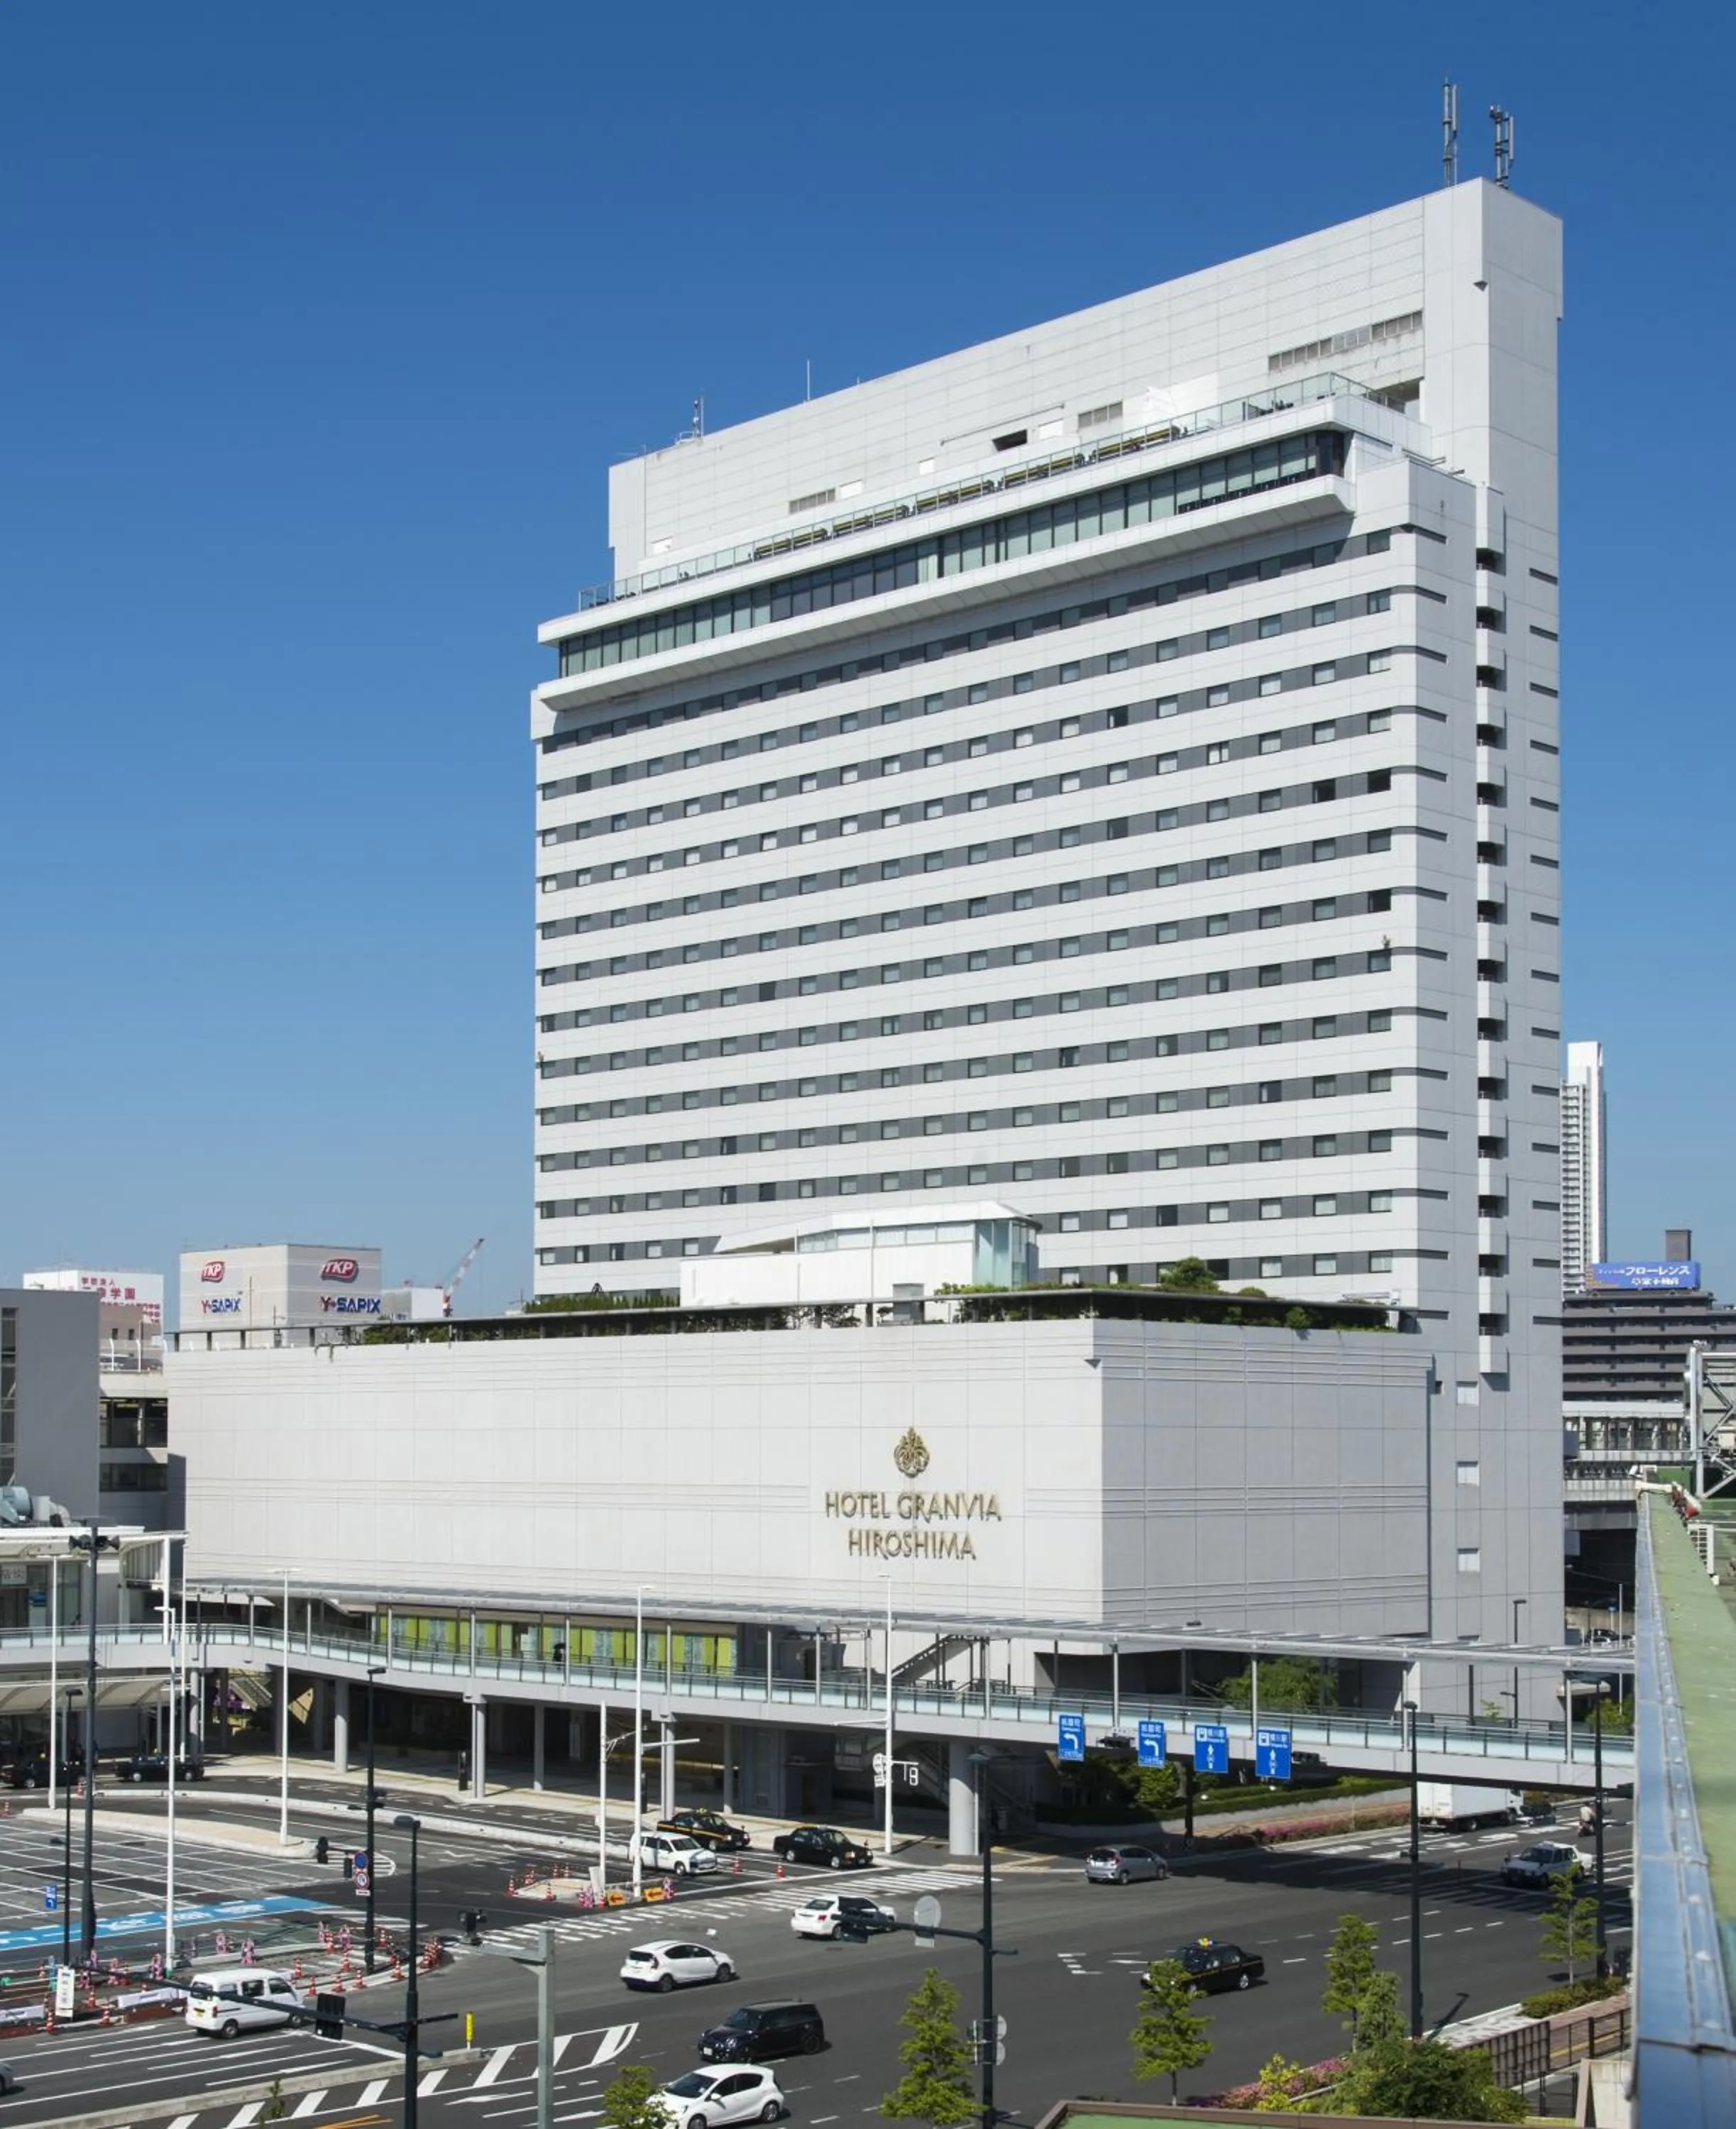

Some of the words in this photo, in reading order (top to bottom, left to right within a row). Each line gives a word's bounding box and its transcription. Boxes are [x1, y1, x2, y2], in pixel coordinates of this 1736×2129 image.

[203, 1264, 221, 1277] TKP
[325, 1260, 353, 1275] TKP
[1625, 1265, 1691, 1277] フローレンス
[825, 1491, 891, 1520] HOTEL
[896, 1492, 1002, 1524] GRANVIA
[848, 1527, 977, 1561] HIROSHIMA
